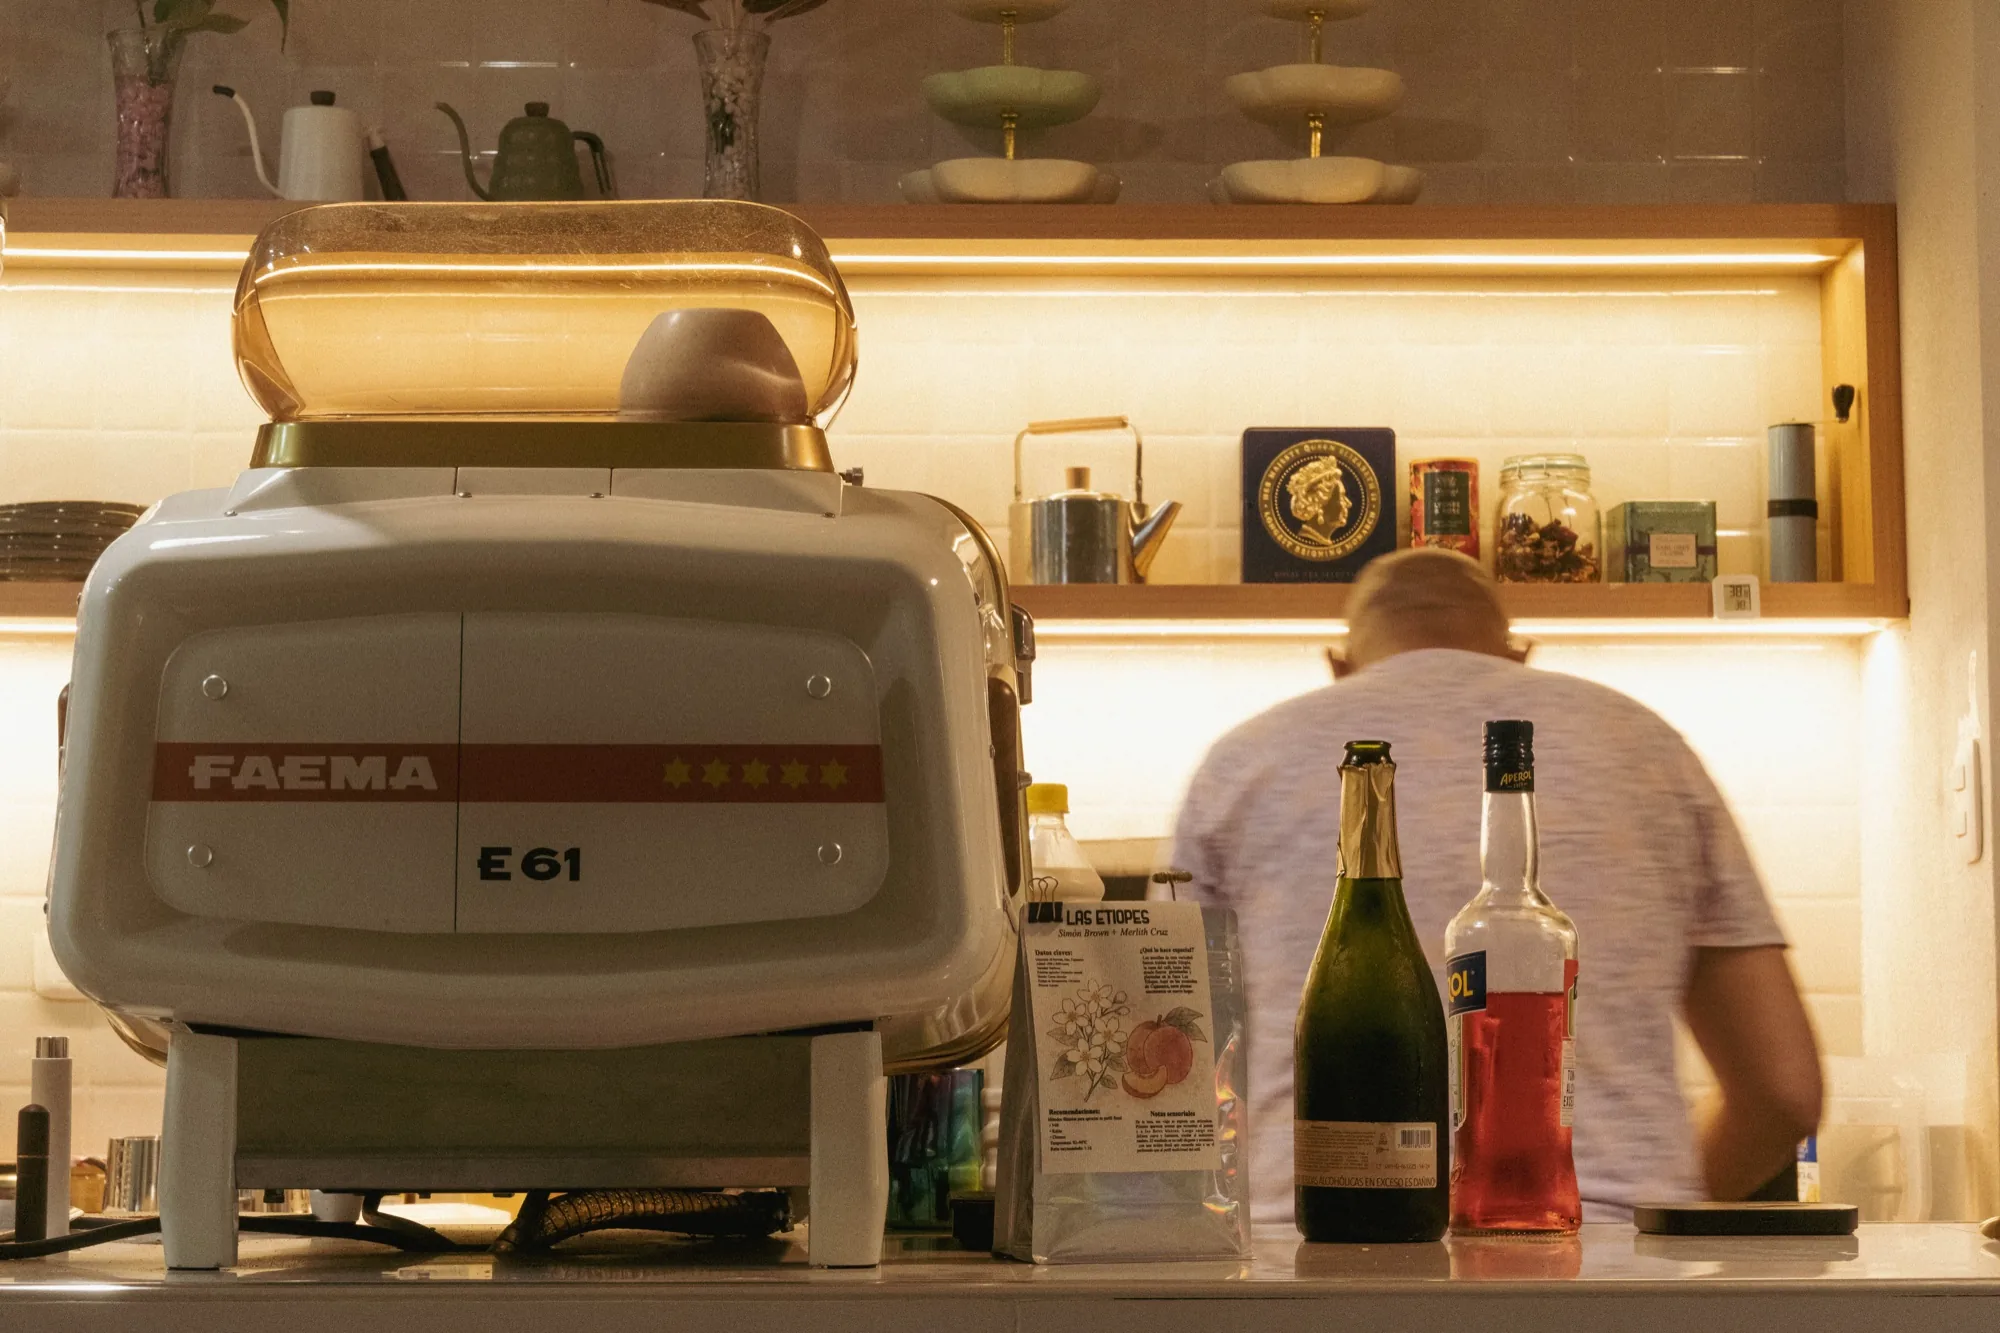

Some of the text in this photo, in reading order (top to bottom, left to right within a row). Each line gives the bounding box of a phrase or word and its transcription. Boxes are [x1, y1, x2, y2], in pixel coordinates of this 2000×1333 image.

[1268, 447, 1301, 480] MAJESTY
[1339, 448, 1376, 490] ELIZABETH
[1294, 546, 1343, 558] REIGNING
[1344, 511, 1376, 550] MONARCH
[188, 755, 438, 790] FAEMA
[1500, 770, 1532, 786] APEROL
[477, 847, 580, 881] E 61
[1066, 909, 1150, 925] LAS ETIOPES
[1058, 928, 1082, 938] Simón
[1084, 928, 1110, 937] Brown
[1120, 927, 1148, 937] Merlith
[1150, 927, 1169, 936] Cruz
[1319, 1174, 1364, 1187] ALCOHÓLICAS
[1365, 1177, 1375, 1187] EN
[1376, 1177, 1404, 1188] EXCESO
[1404, 1177, 1413, 1187] ES
